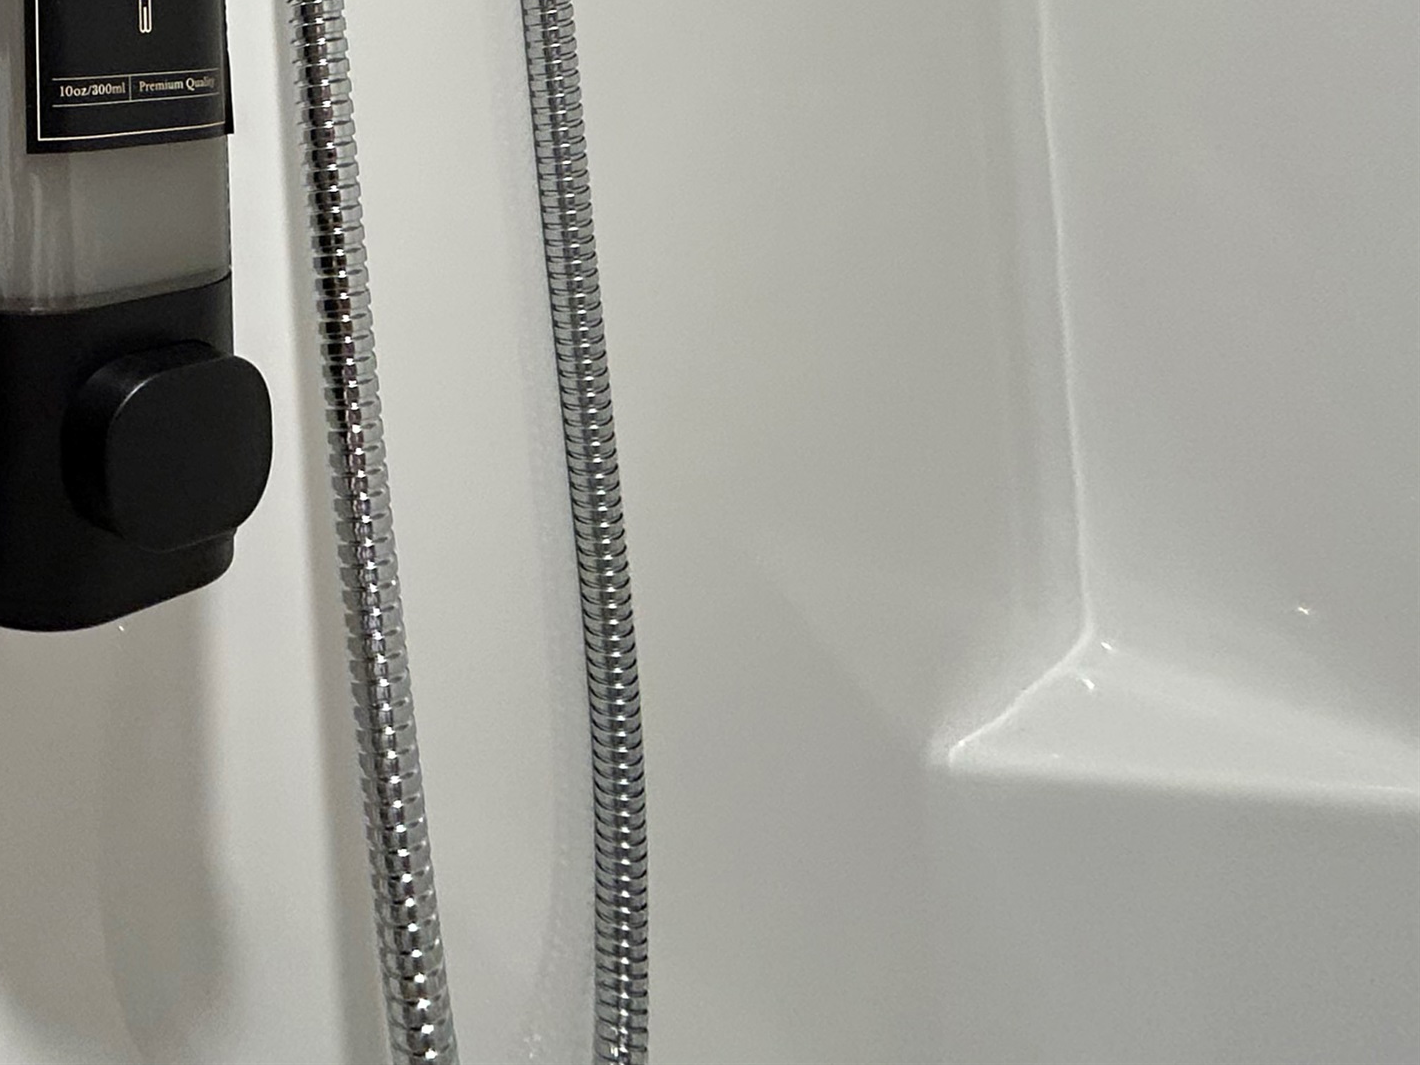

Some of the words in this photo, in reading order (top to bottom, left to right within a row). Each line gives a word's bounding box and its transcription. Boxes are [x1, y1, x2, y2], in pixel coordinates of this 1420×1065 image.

[59, 82, 126, 97] 10oz/300ml
[139, 79, 184, 92] Premium
[186, 76, 215, 90] Quality
